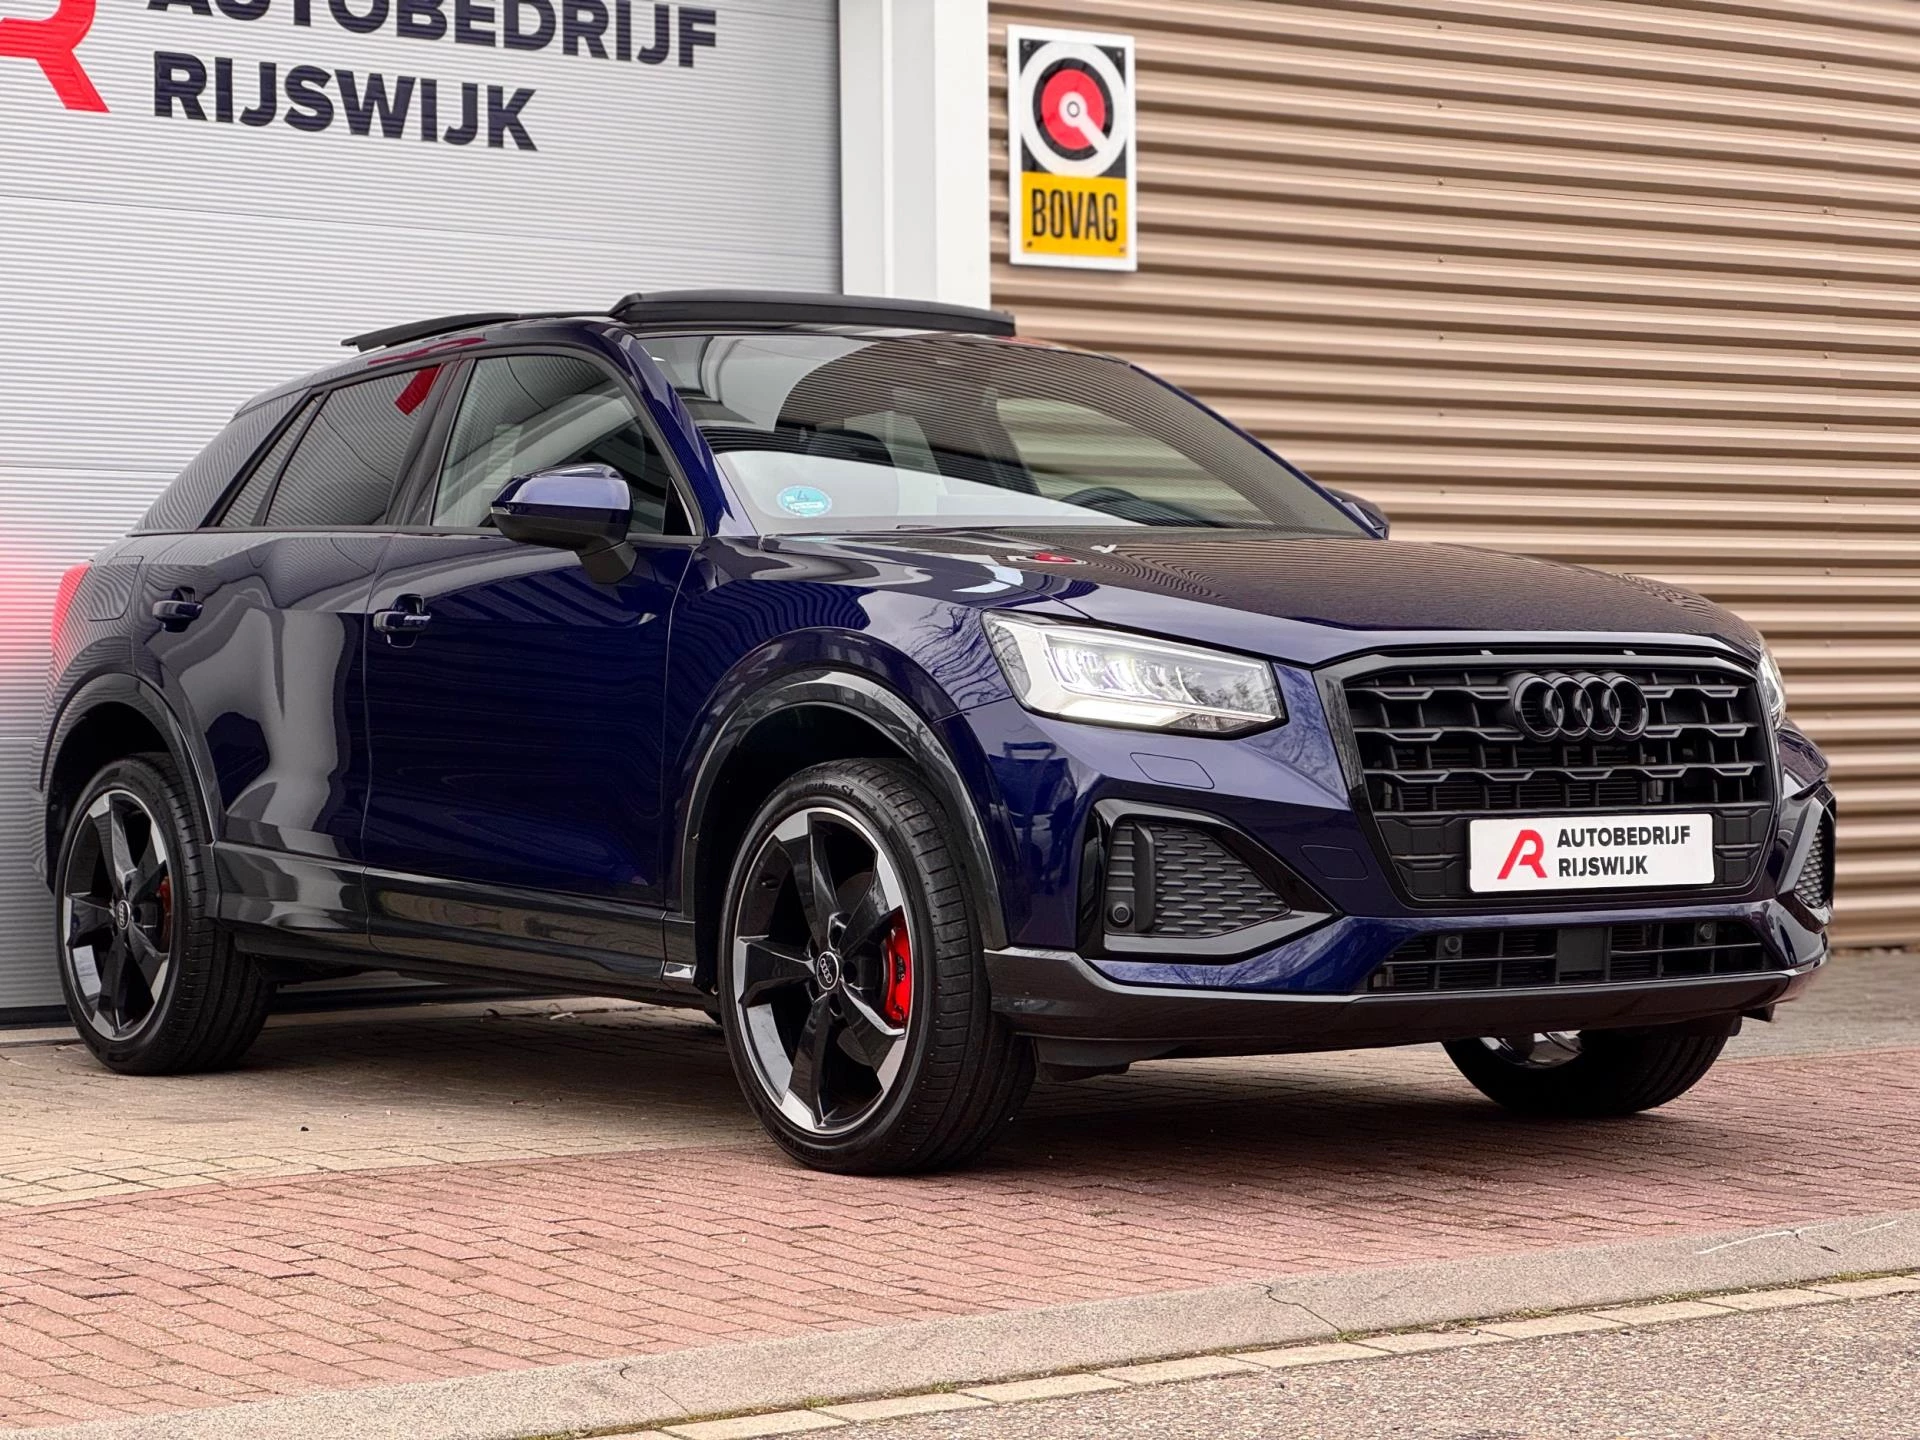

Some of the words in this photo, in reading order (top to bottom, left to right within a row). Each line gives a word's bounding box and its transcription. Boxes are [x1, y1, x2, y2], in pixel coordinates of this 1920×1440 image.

[146, 0, 717, 69] OBEDRIJF
[153, 50, 538, 152] RIJSWIJK
[1031, 188, 1118, 242] BOVAG
[1557, 825, 1691, 848] AUTOBEDRIJF
[1558, 855, 1649, 878] RIJSWIJK
